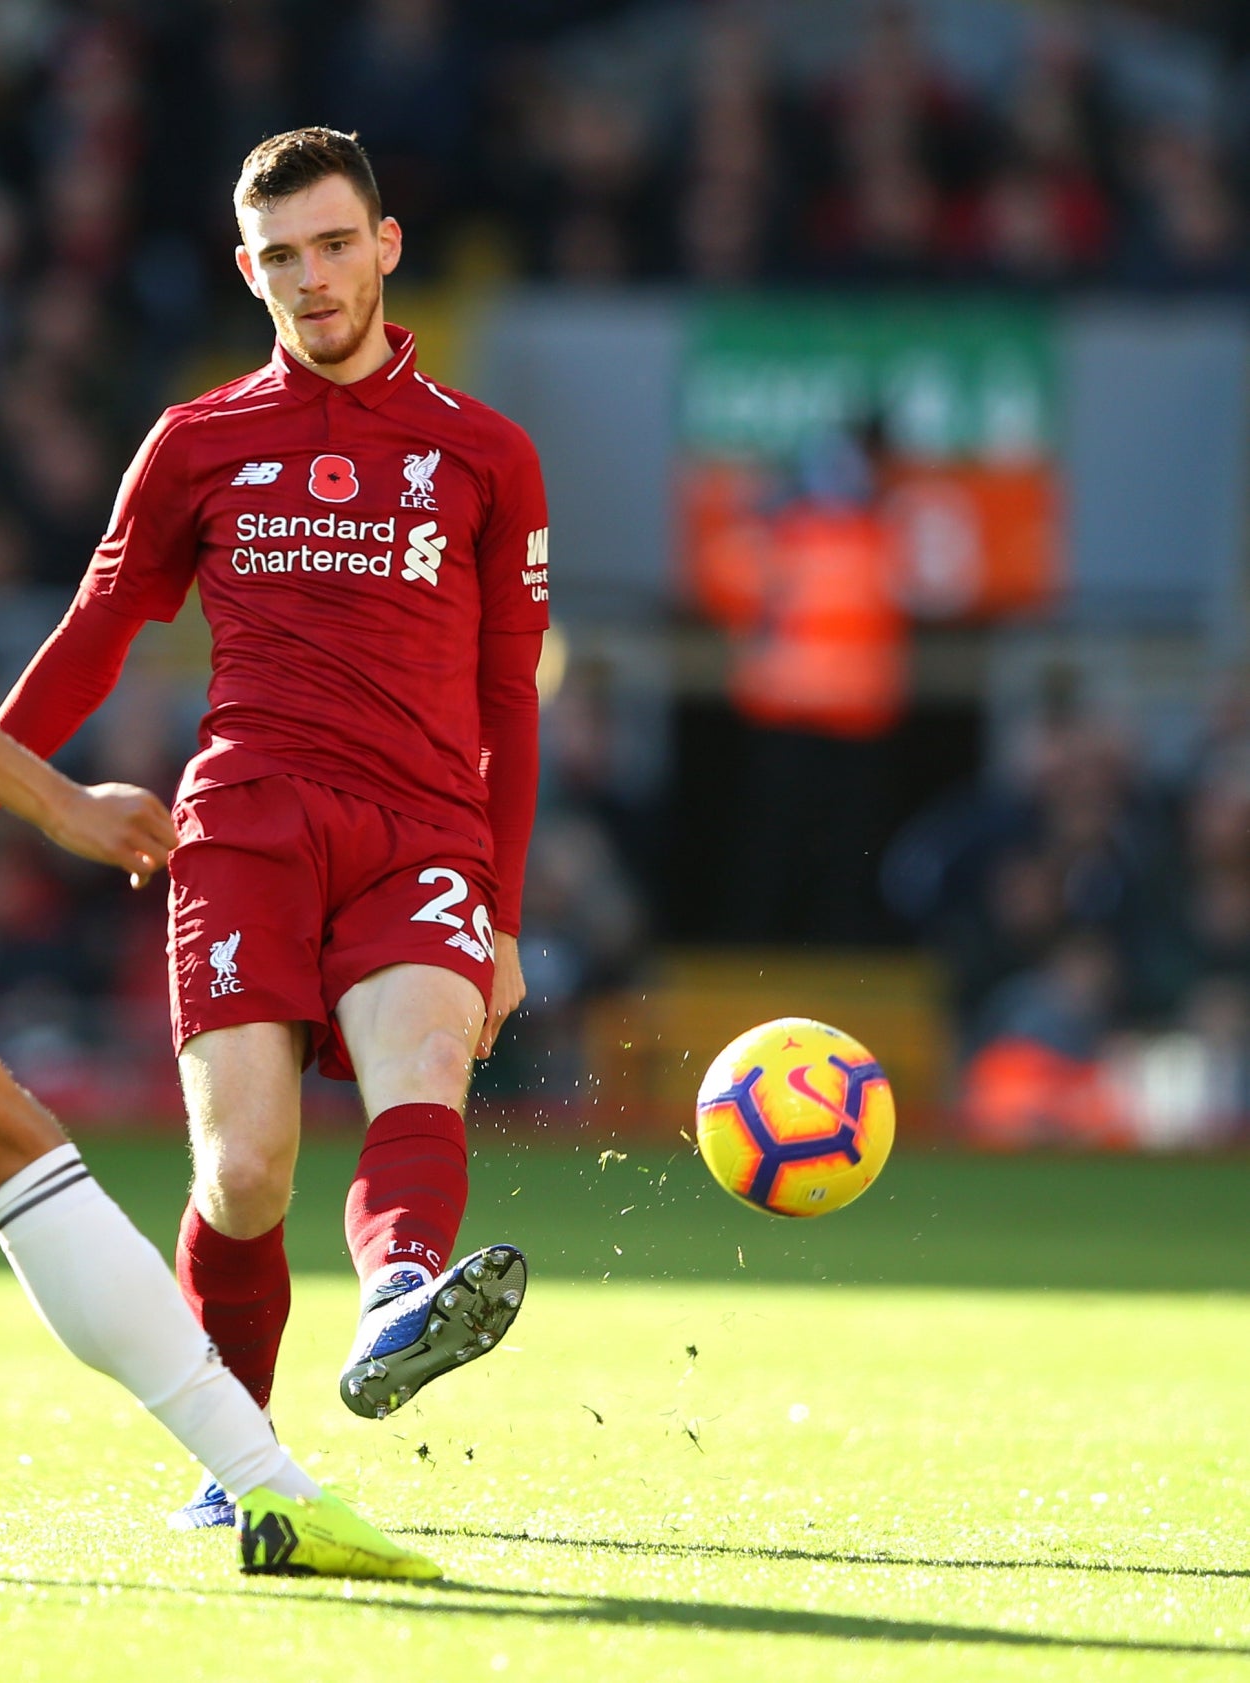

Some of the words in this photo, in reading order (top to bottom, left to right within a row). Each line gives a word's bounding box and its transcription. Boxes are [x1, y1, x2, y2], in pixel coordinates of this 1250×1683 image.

[235, 512, 396, 543] Standard
[231, 545, 393, 577] Chartered
[410, 867, 495, 963] 26
